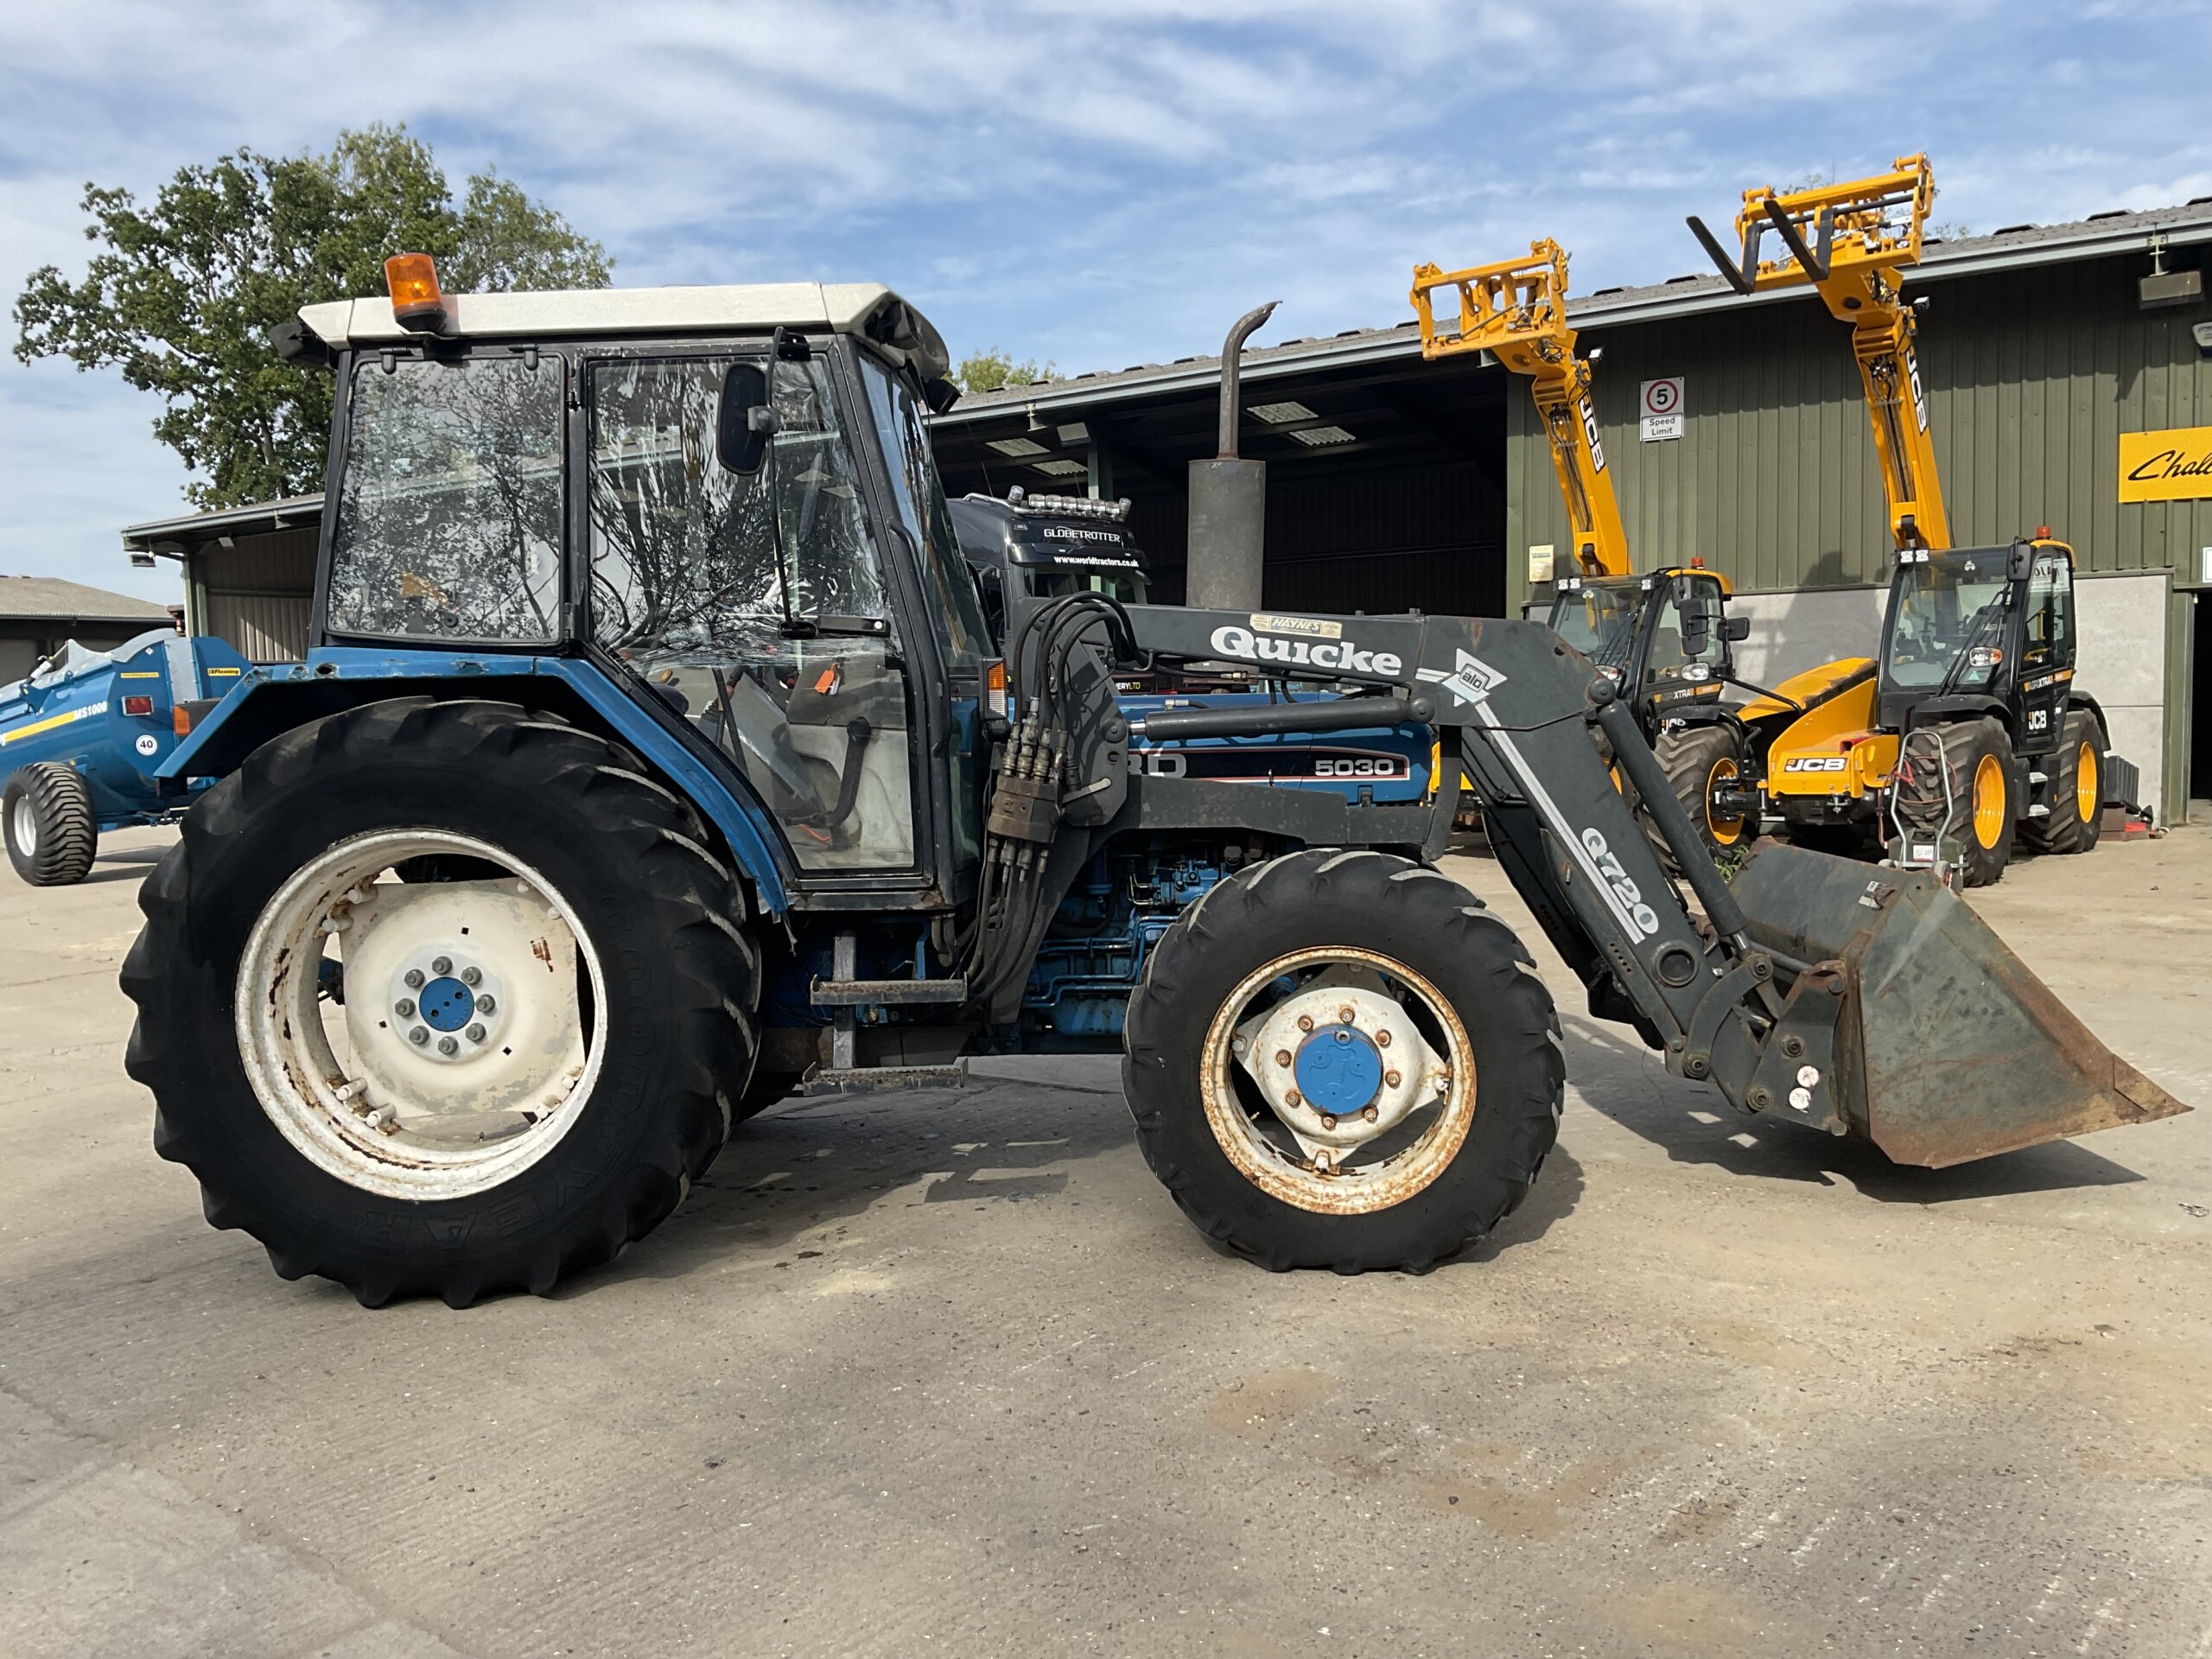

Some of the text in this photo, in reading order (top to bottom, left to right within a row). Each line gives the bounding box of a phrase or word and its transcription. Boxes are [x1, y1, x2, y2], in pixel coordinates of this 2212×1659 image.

[1656, 388, 1669, 405] 5
[1906, 349, 1927, 433] JCB
[1649, 416, 1675, 428] Speed
[1580, 397, 1605, 472] JCB
[1651, 427, 1673, 436] Limit
[1043, 528, 1121, 543] GLOBETROTTER
[1053, 556, 1140, 568] www.worldtractors.co.uk
[1271, 618, 1320, 631] HAYNES
[1210, 626, 1403, 676] Quicke
[74, 701, 108, 721] MS1000
[2028, 709, 2047, 731] JCB
[140, 740, 154, 749] 40
[1314, 759, 1395, 776] 5030
[1785, 758, 1846, 772] JCB
[1581, 827, 1659, 934] Q720
